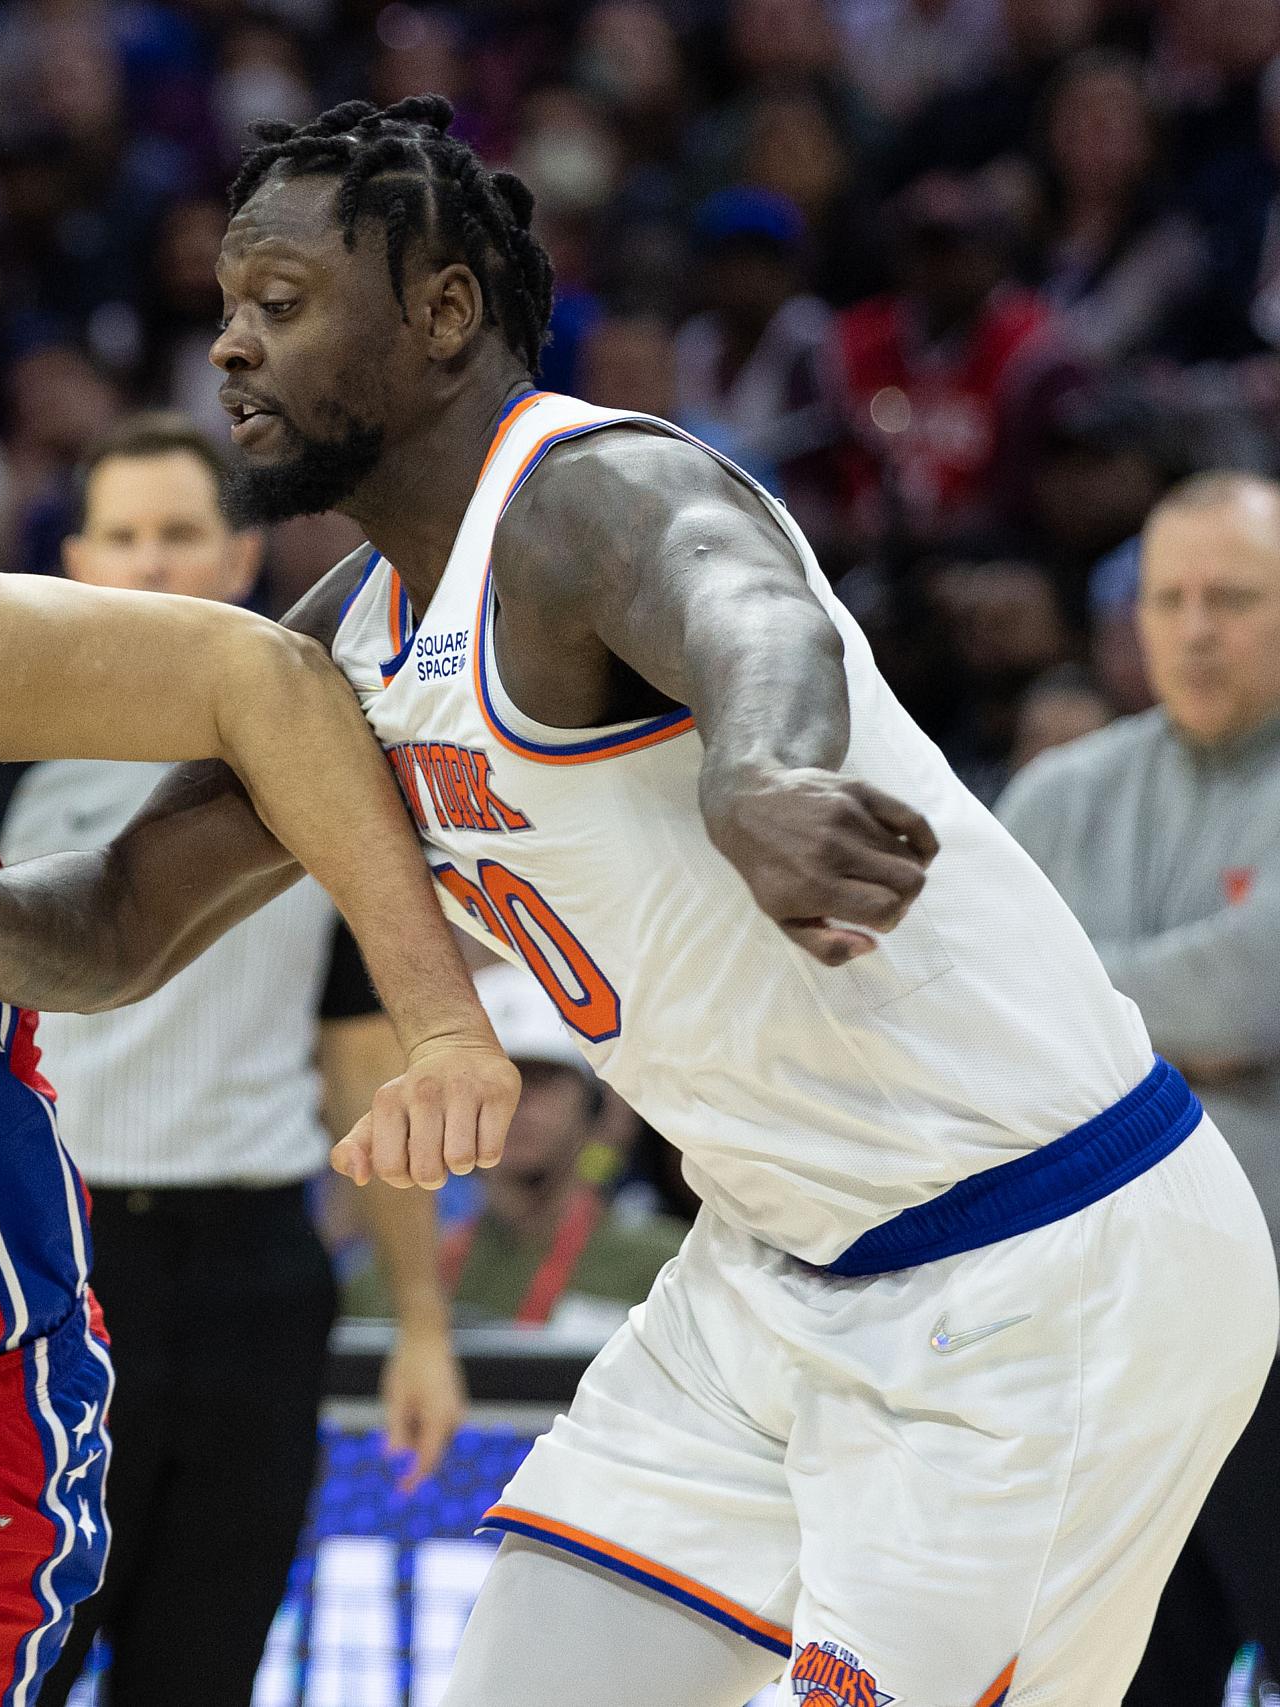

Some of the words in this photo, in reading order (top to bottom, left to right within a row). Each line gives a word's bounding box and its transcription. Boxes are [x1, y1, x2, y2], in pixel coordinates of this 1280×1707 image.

[416, 630, 469, 658] SQUARE
[417, 656, 459, 681] SPACE
[412, 742, 537, 834] YORK
[821, 1640, 839, 1655] NEW
[839, 1647, 860, 1671] YORK
[791, 1641, 877, 1707] KNICKS
